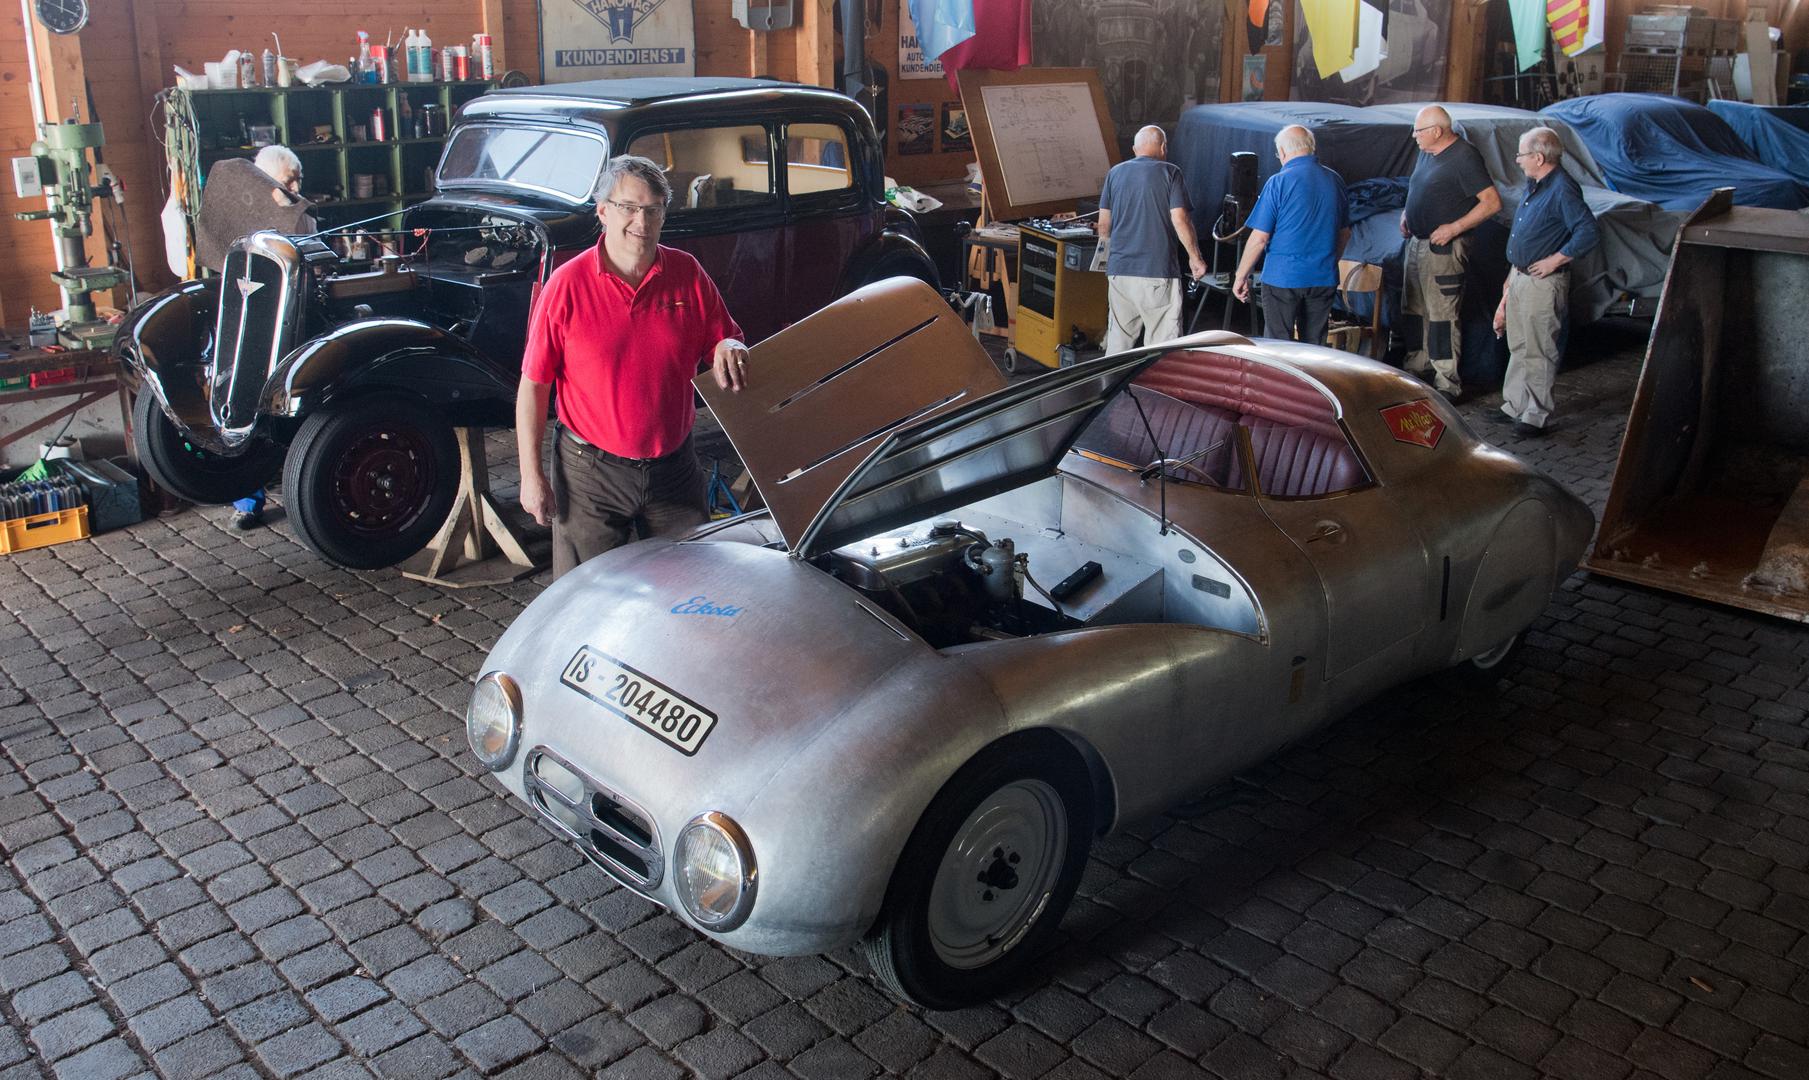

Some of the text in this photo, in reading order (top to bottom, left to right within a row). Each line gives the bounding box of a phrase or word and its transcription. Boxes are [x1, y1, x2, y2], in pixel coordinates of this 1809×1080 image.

[562, 50, 679, 65] KUNDENDIENST
[670, 596, 743, 617] Eckold
[569, 653, 597, 683] IS
[604, 673, 702, 743] 204480
